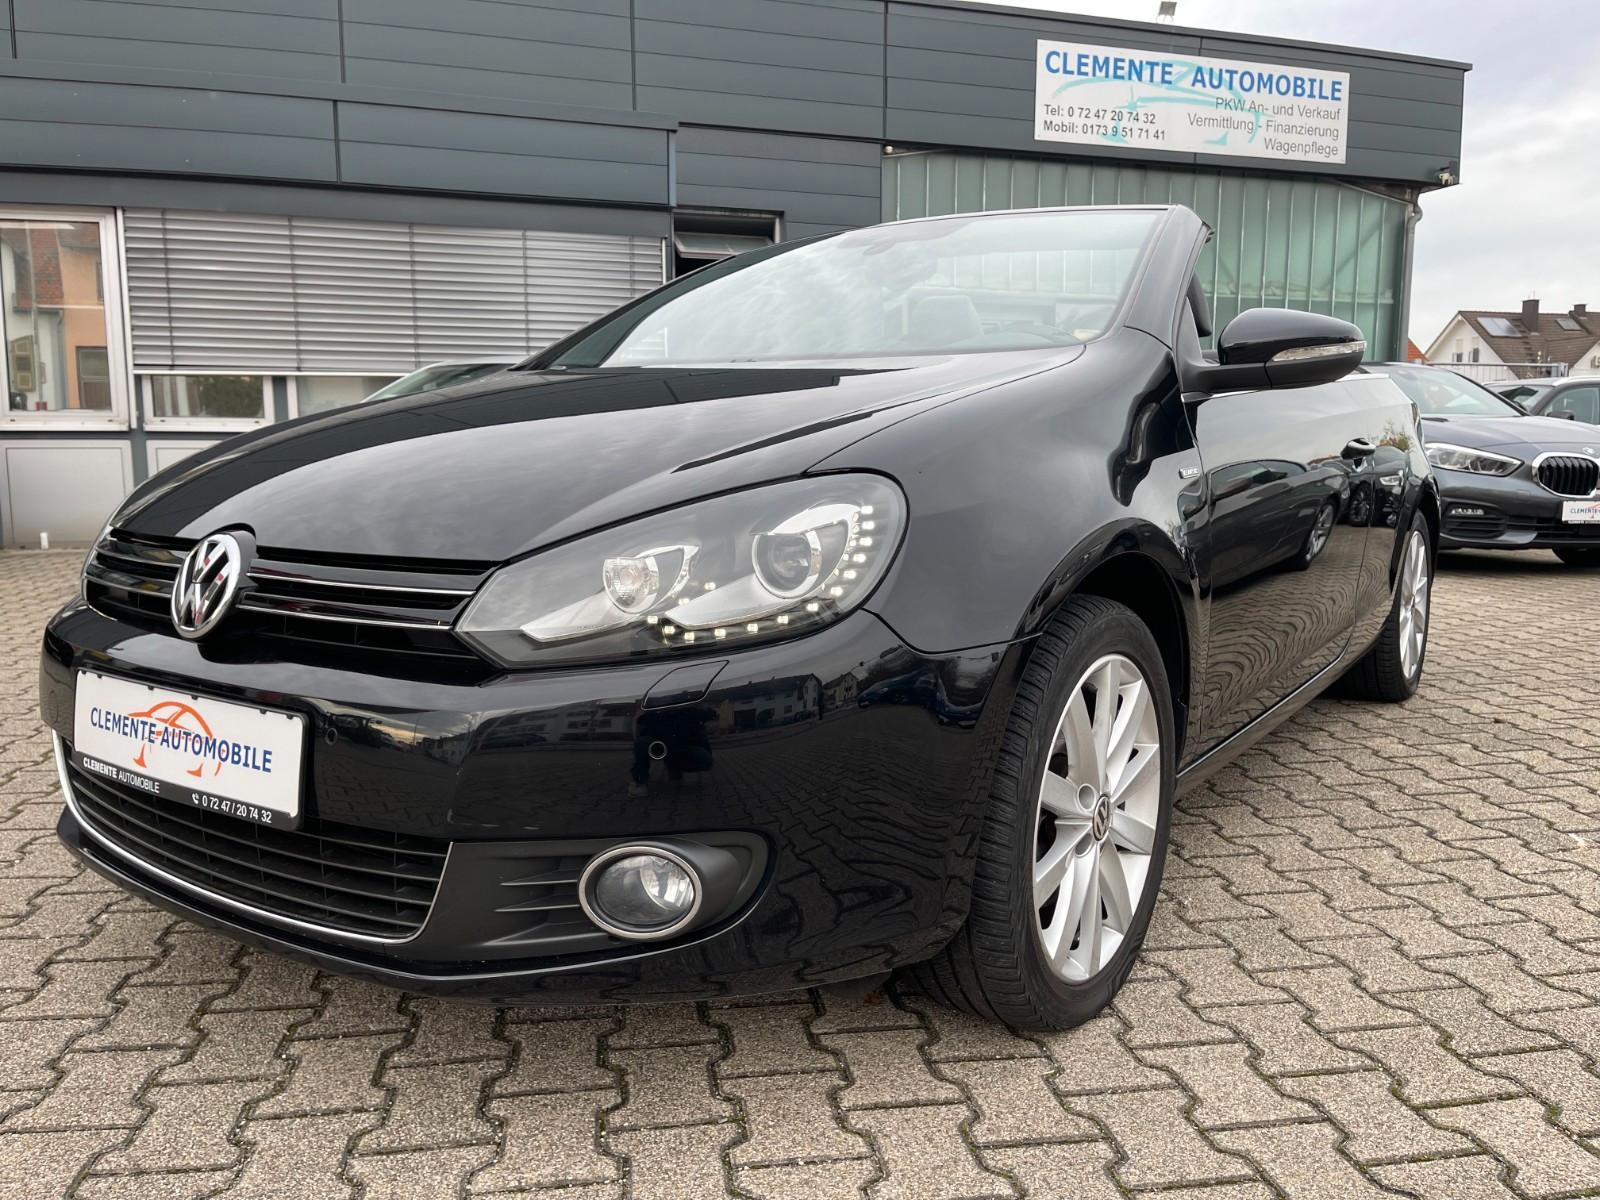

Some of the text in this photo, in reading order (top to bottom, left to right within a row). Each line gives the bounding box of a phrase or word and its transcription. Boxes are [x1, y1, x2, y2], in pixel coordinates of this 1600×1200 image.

[1045, 50, 1343, 102] CLEMENTE AUTOMOBILE
[1044, 104, 1156, 125] Tel: 0 72 47 20 74 32
[1215, 96, 1341, 121] PKW An- und Verkauf
[1043, 120, 1166, 141] Mobil: 0173 9 51 71 41
[1187, 112, 1254, 134] Vermittlung
[1265, 119, 1340, 141] Finanzierung
[1264, 137, 1339, 158] Wagenpflege
[90, 706, 273, 774] CLEMENTE AUTOMOBILE
[83, 756, 160, 794] CLEMENTE AUTOMOBILE
[202, 795, 208, 807] 0
[209, 796, 219, 810] 72
[248, 806, 259, 820] 74
[261, 809, 272, 824] 32
